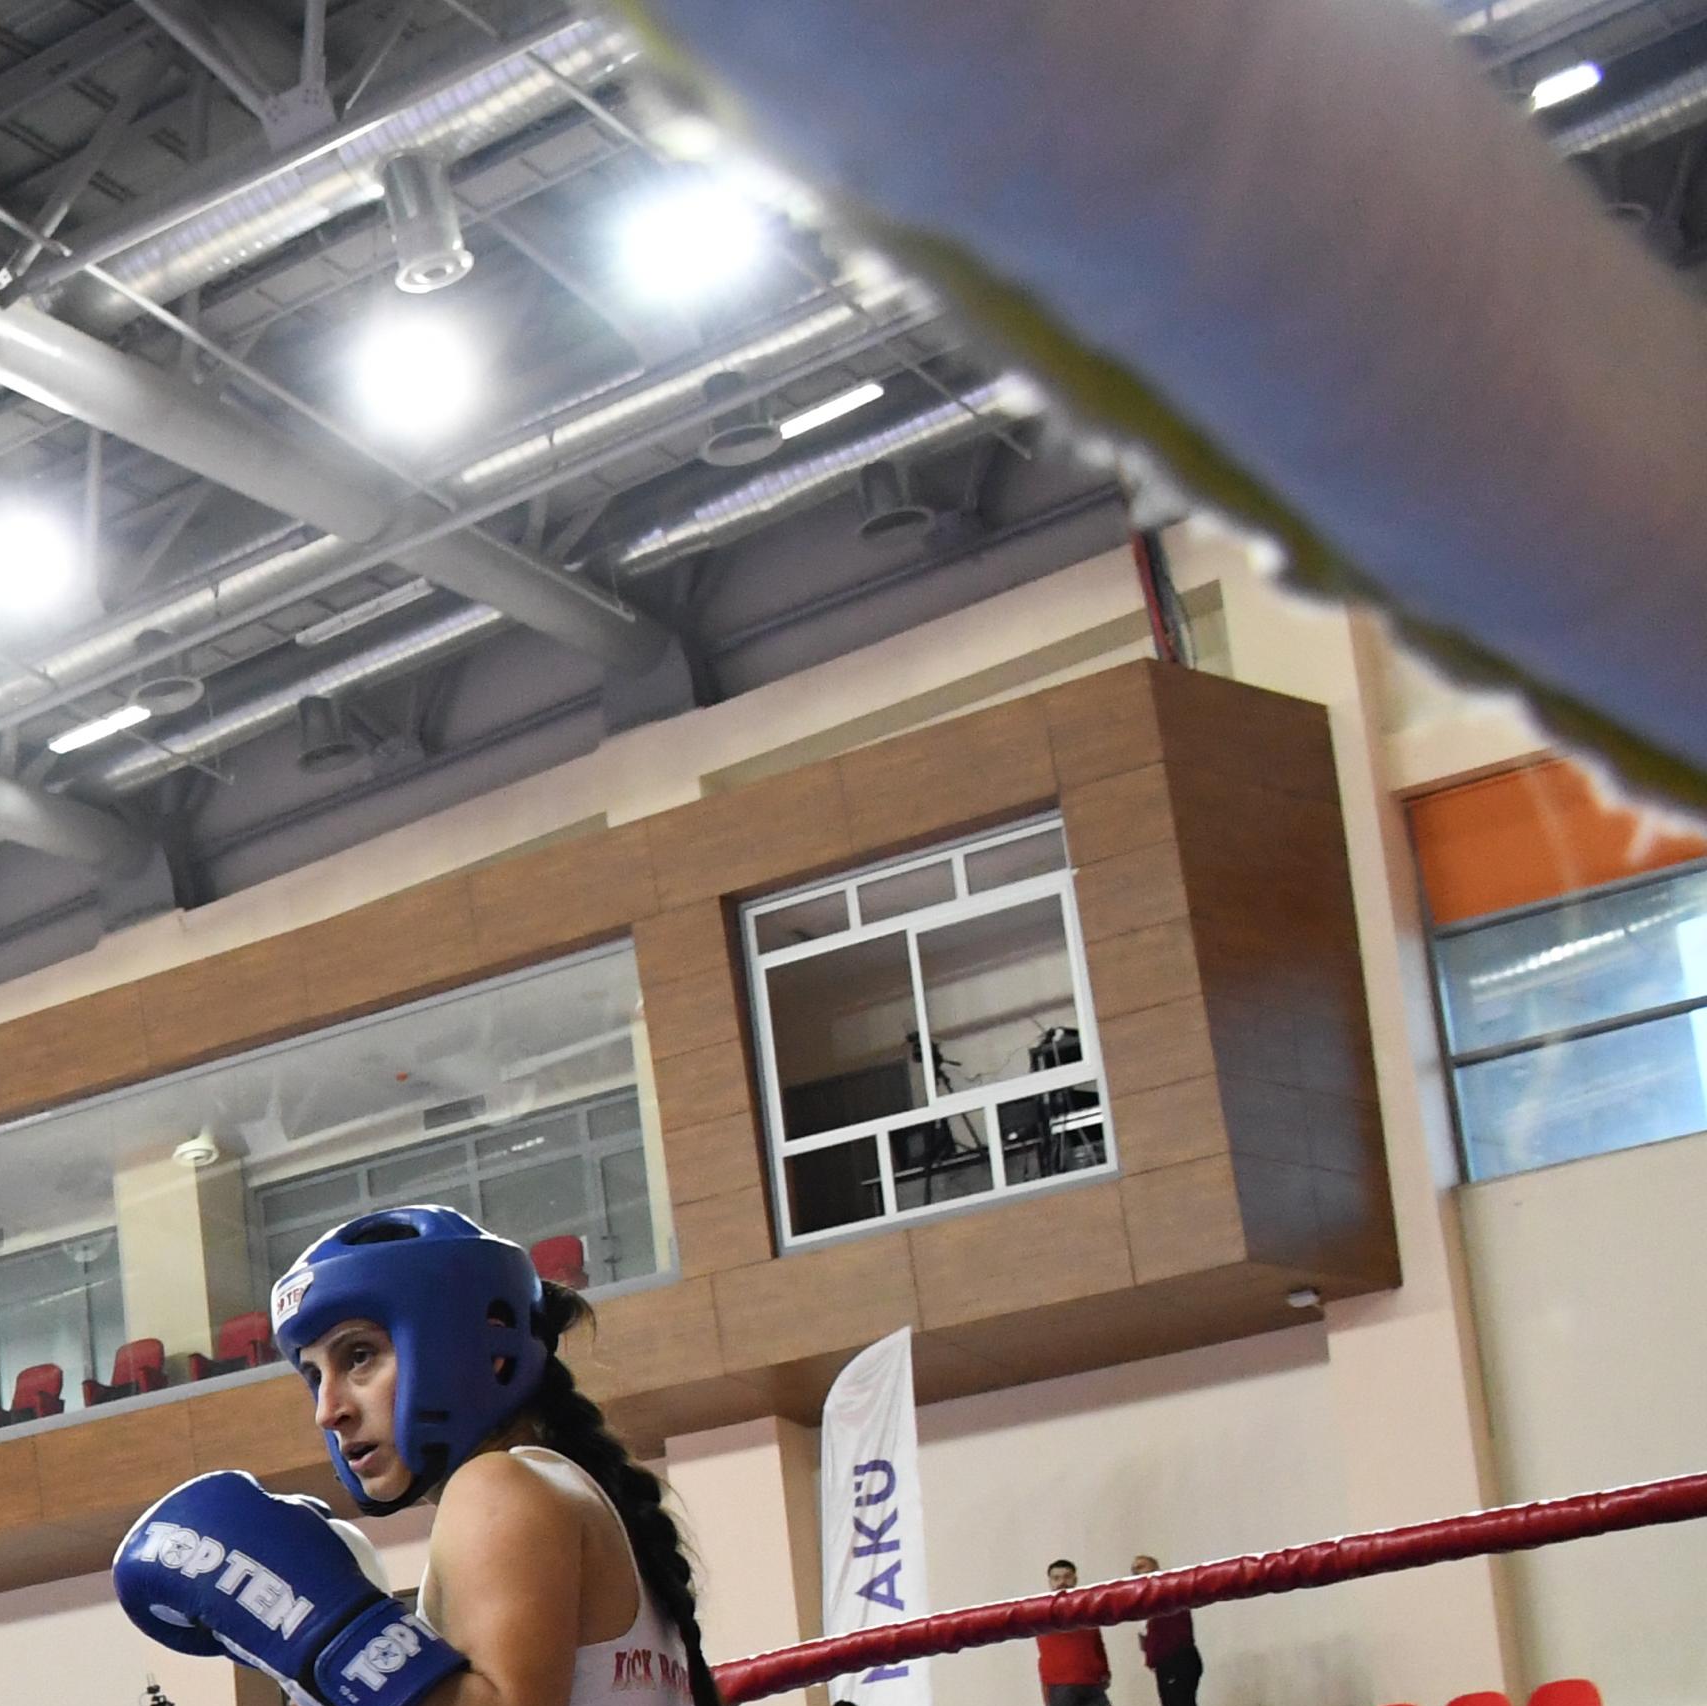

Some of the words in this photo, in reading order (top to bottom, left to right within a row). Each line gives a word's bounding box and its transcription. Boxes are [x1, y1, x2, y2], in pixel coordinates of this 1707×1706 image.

[140, 1521, 226, 1578] TOP
[215, 1549, 315, 1640] TEN
[341, 1623, 421, 1692] TOP
